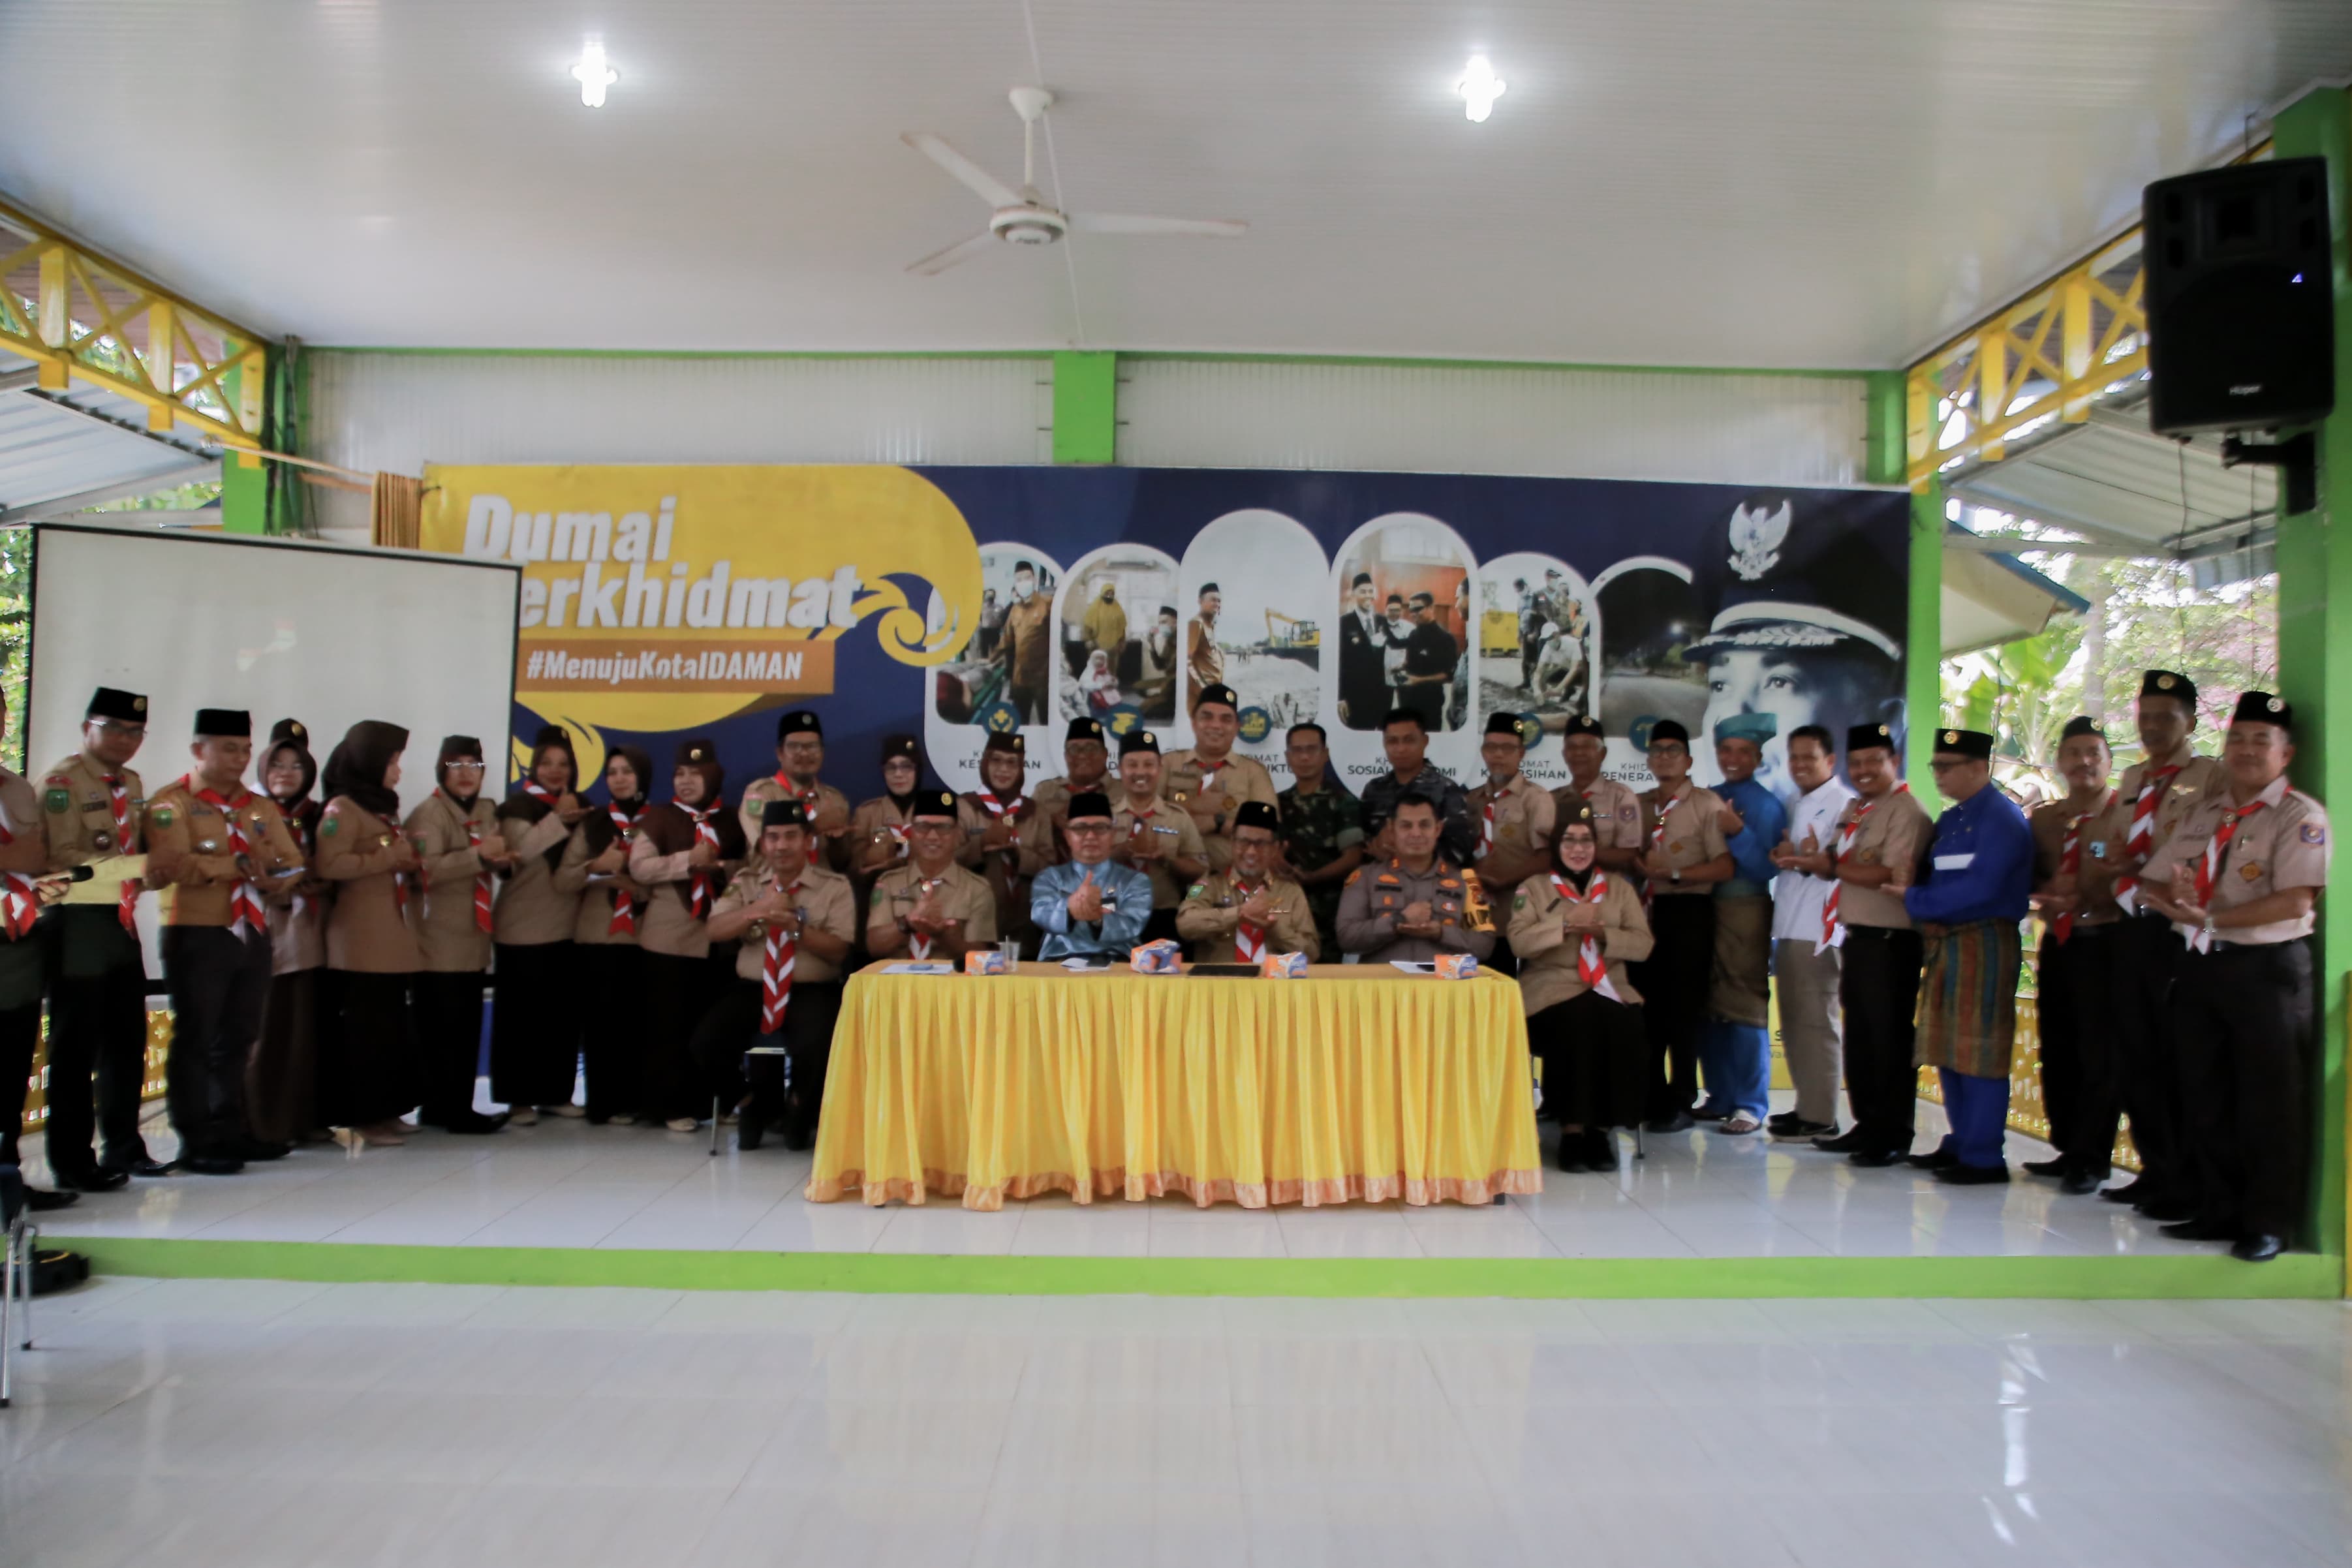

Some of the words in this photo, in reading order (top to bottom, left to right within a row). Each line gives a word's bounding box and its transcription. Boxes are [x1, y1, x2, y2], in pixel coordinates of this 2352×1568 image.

[463, 494, 677, 562] Dumai
[520, 559, 859, 628] erkhidmat
[527, 651, 803, 684] #MenujuKotaIDAMAN
